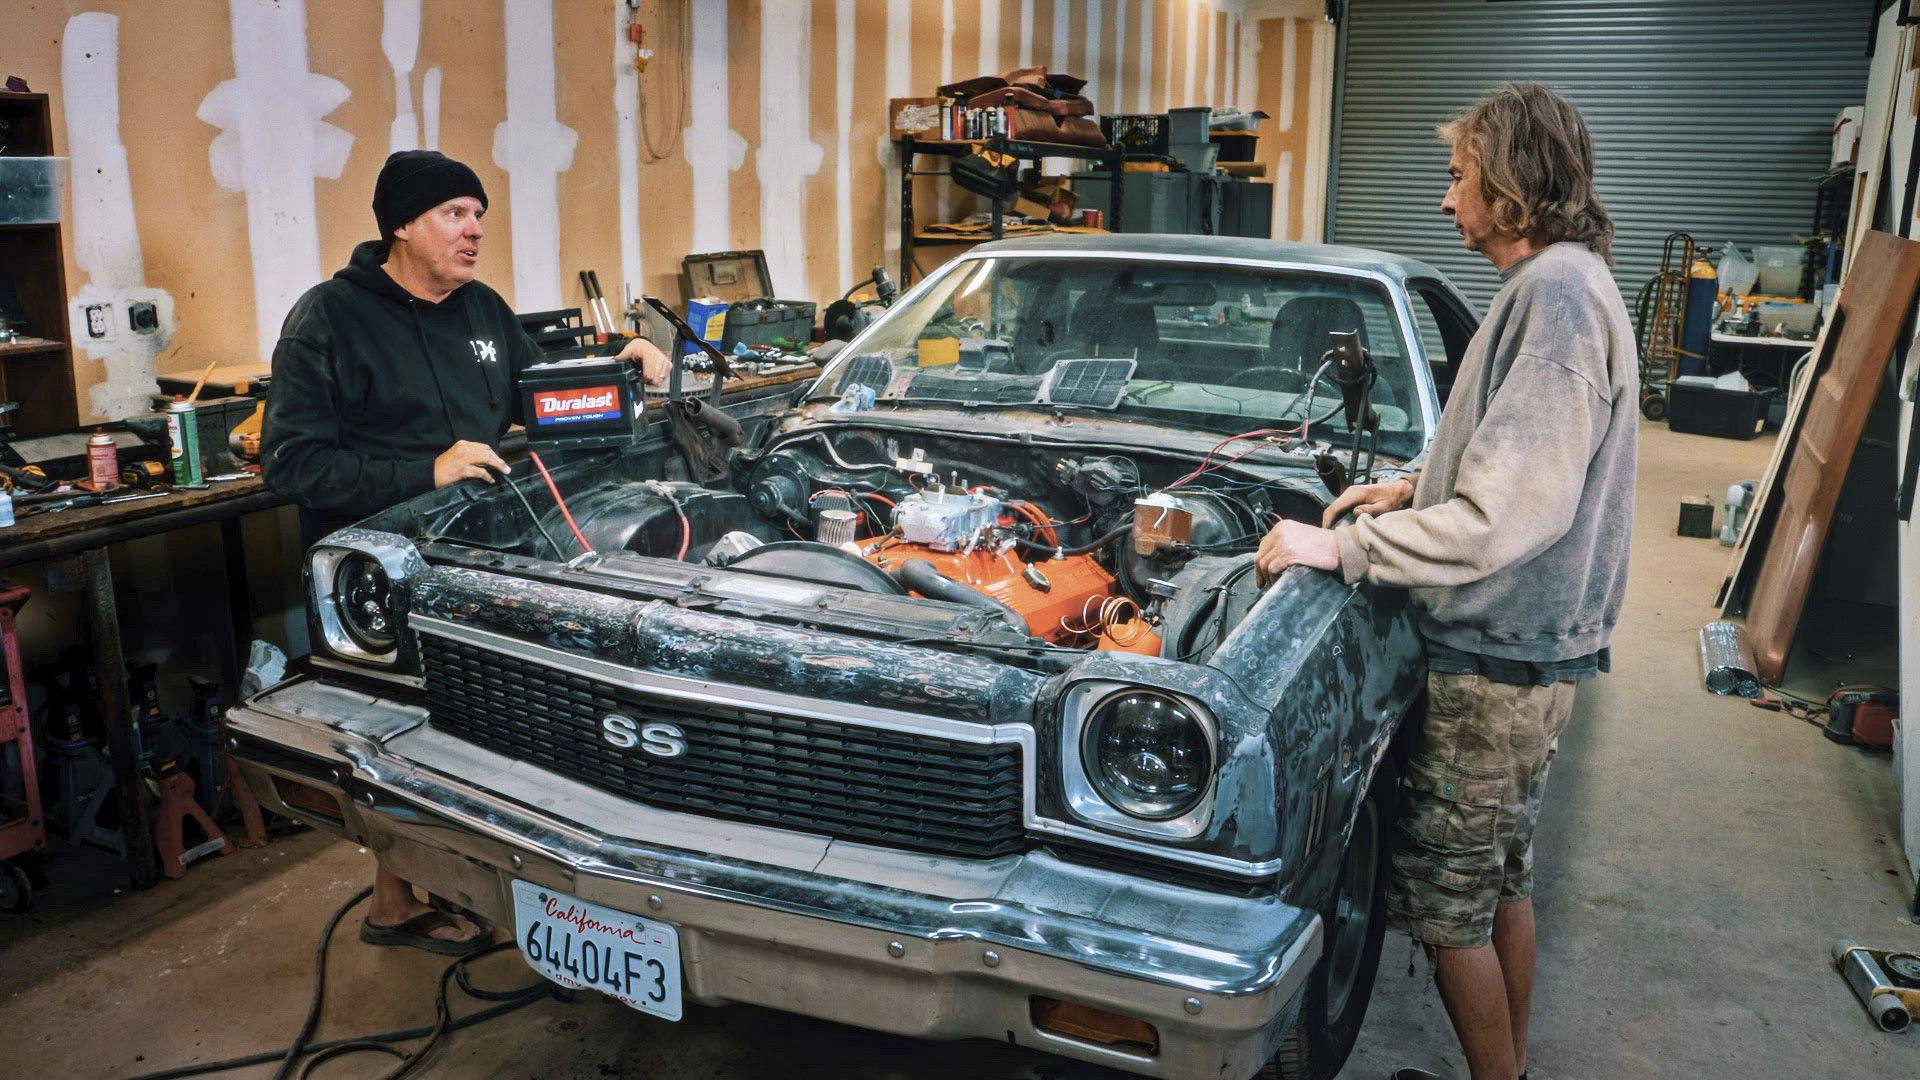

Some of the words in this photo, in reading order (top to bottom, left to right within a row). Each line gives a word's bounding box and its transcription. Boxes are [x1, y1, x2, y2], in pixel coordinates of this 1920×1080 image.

[540, 392, 613, 413] Duralast
[602, 713, 688, 757] SS
[545, 897, 646, 945] California
[526, 921, 666, 1002] 64404F3
